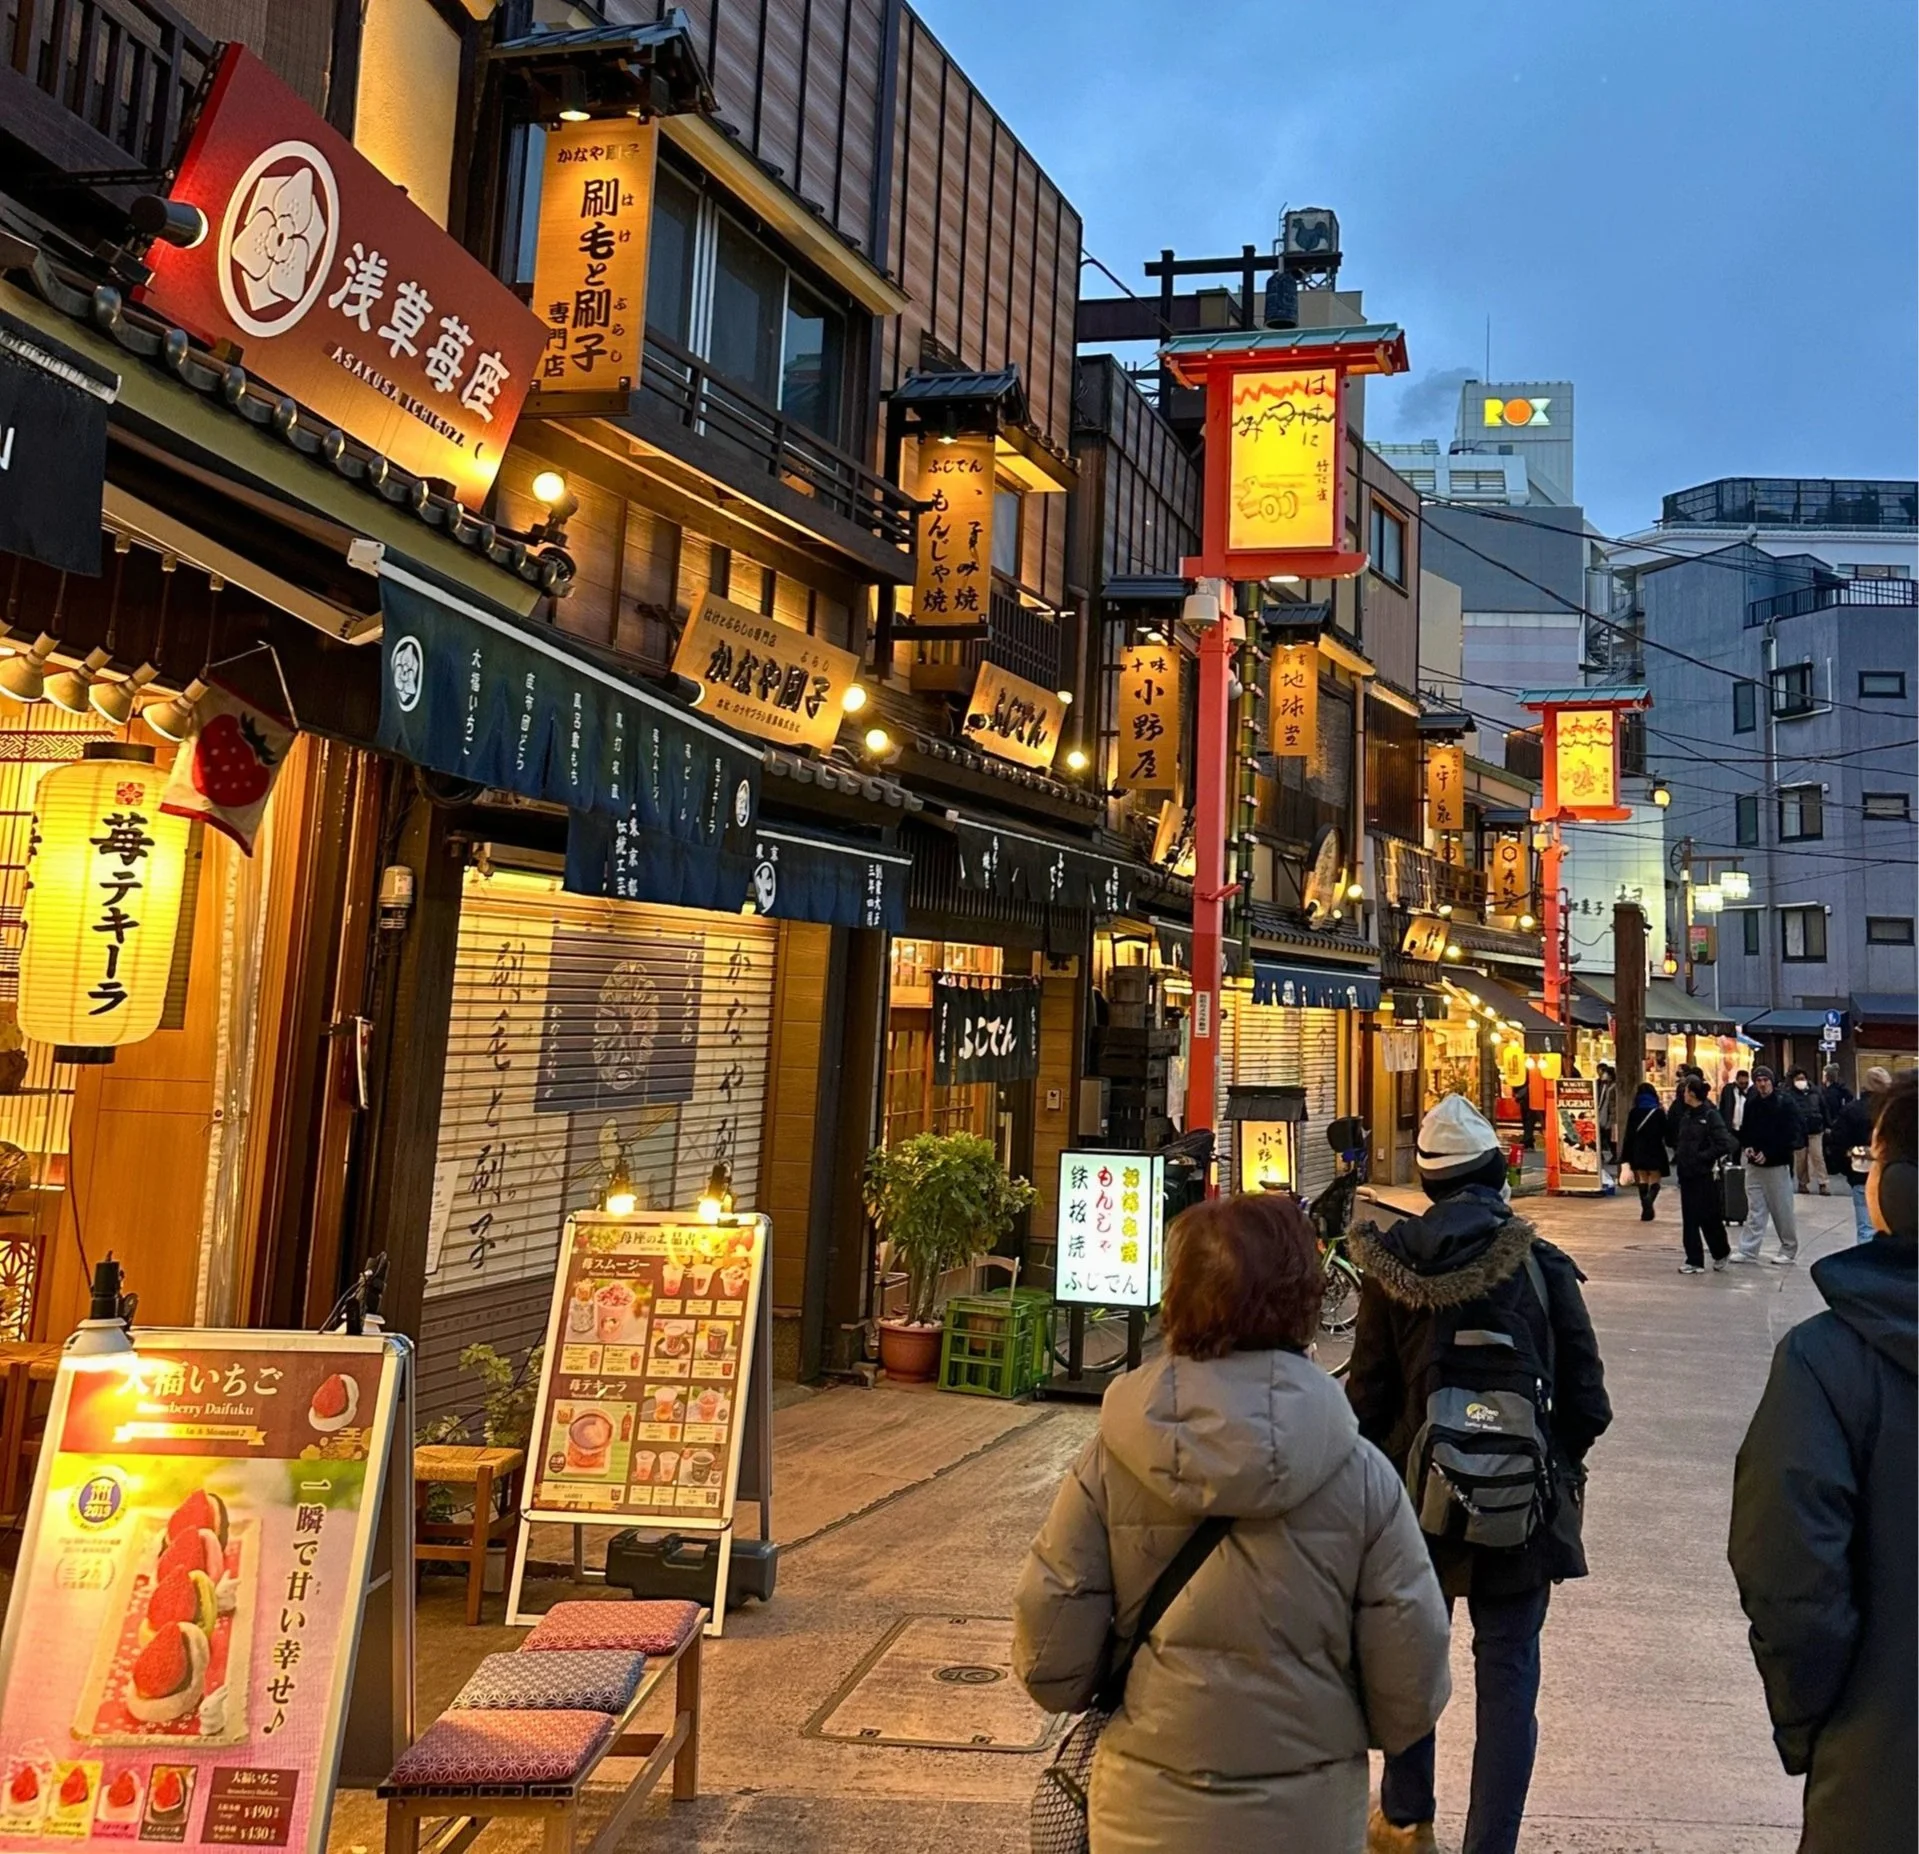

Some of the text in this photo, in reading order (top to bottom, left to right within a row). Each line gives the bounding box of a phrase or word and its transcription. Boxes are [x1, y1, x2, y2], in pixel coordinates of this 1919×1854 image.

[618, 193, 635, 243] はけ
[571, 177, 620, 373] 刷毛と刷子
[328, 242, 511, 424] 浅草苺座
[542, 301, 571, 378] 専門店
[331, 346, 402, 403] ASAKUSA
[1484, 398, 1551, 426] ROX
[927, 459, 983, 474] ふじでん
[922, 488, 951, 614] もんじゃ焼
[1131, 657, 1168, 674] 十味
[88, 811, 155, 1016] 苺テキーラ
[958, 1016, 1018, 1060] ふじでん
[1067, 1165, 1088, 1258] 鉄板焼
[1095, 1166, 1114, 1252] もんじゃ
[581, 1258, 650, 1270] 苺スムージー
[1065, 1271, 1139, 1294] ふじでん
[136, 1401, 254, 1418] berry Daifuku
[569, 1378, 628, 1393] 苺テキーラ
